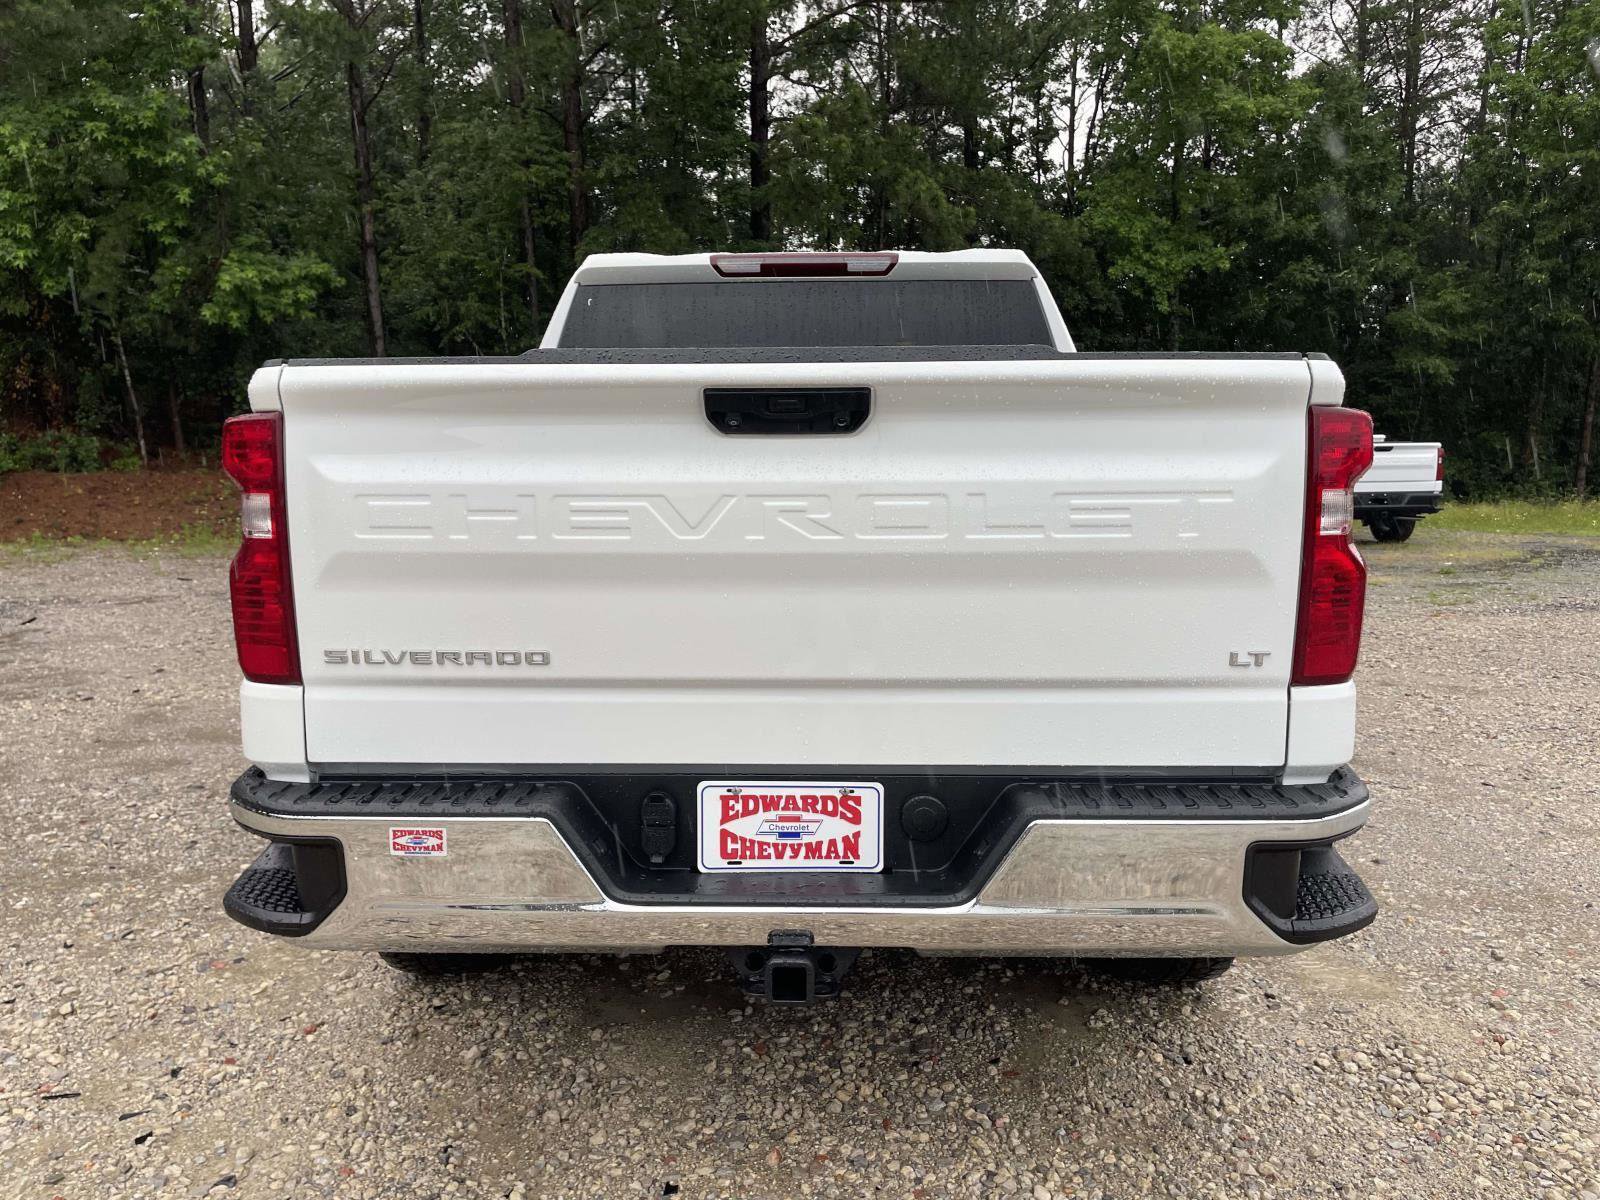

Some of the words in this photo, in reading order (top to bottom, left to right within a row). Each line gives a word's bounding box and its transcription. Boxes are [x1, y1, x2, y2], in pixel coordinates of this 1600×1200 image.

[354, 492, 1234, 540] CHEVROLET
[323, 650, 551, 666] SILVERADO
[1229, 651, 1271, 666] LT
[719, 794, 862, 826] EDWARDS
[768, 823, 810, 831] Chevrolet
[392, 829, 444, 841] EDWARDS
